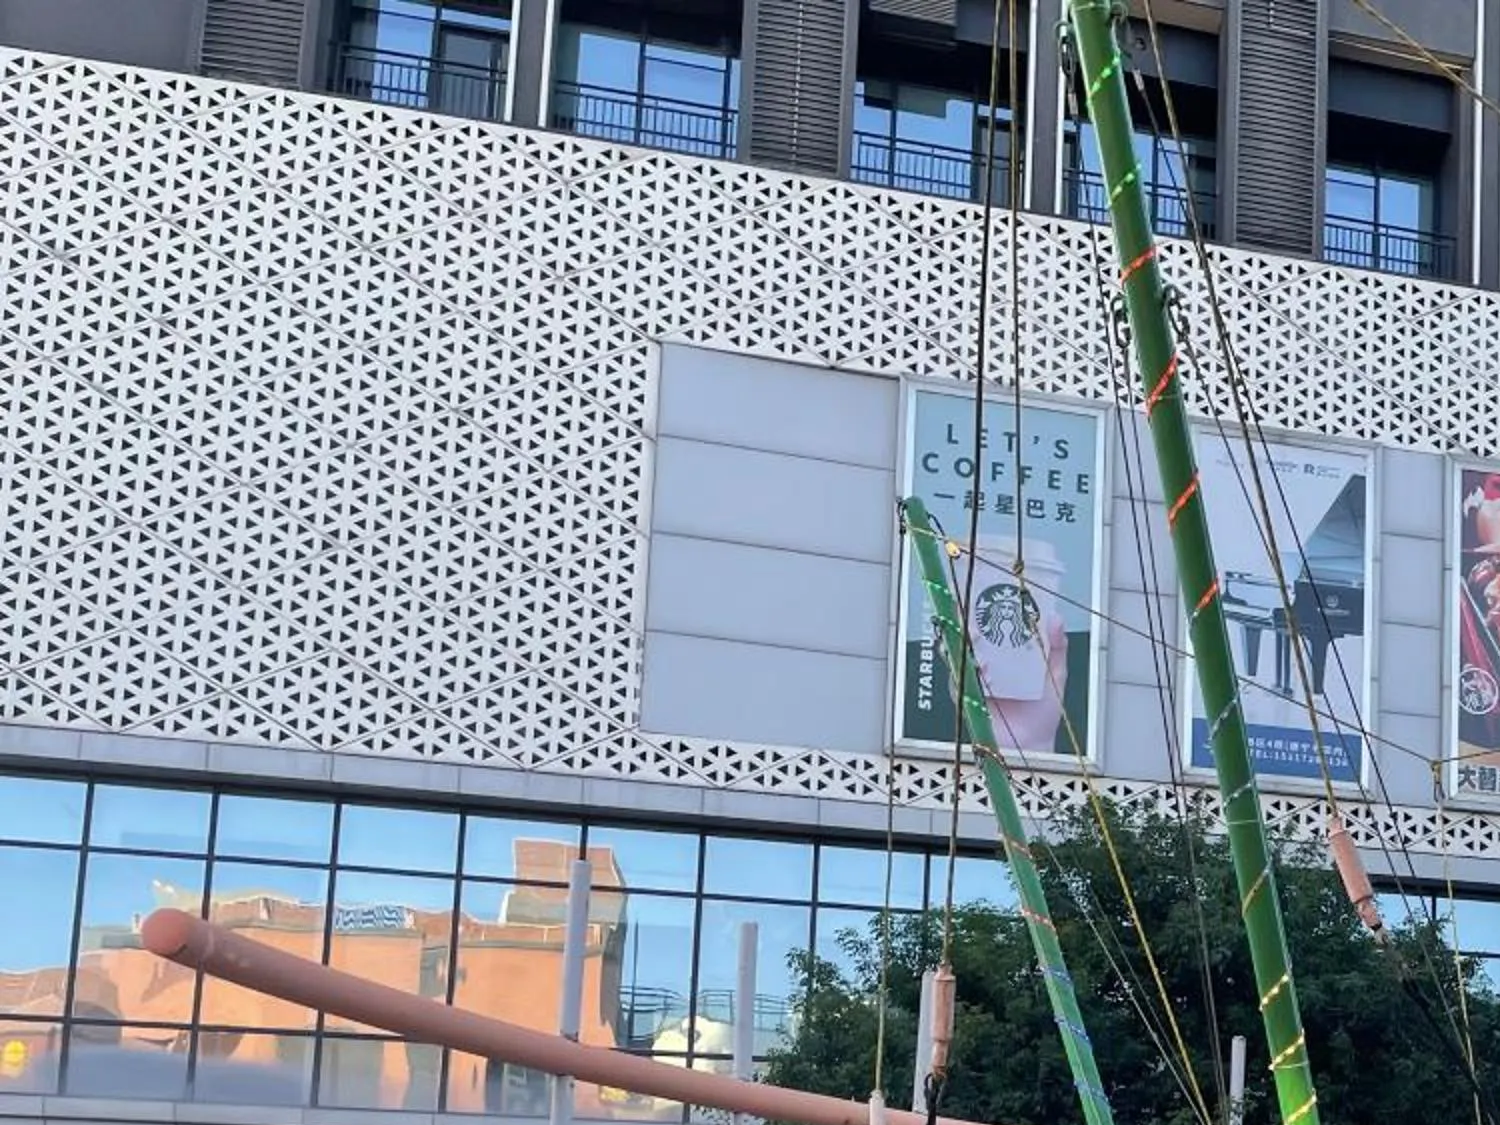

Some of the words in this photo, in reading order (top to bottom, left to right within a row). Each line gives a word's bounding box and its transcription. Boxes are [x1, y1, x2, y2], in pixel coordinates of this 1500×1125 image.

[921, 452, 1090, 495] COFFEE
[933, 489, 1077, 524] 一起星巴克
